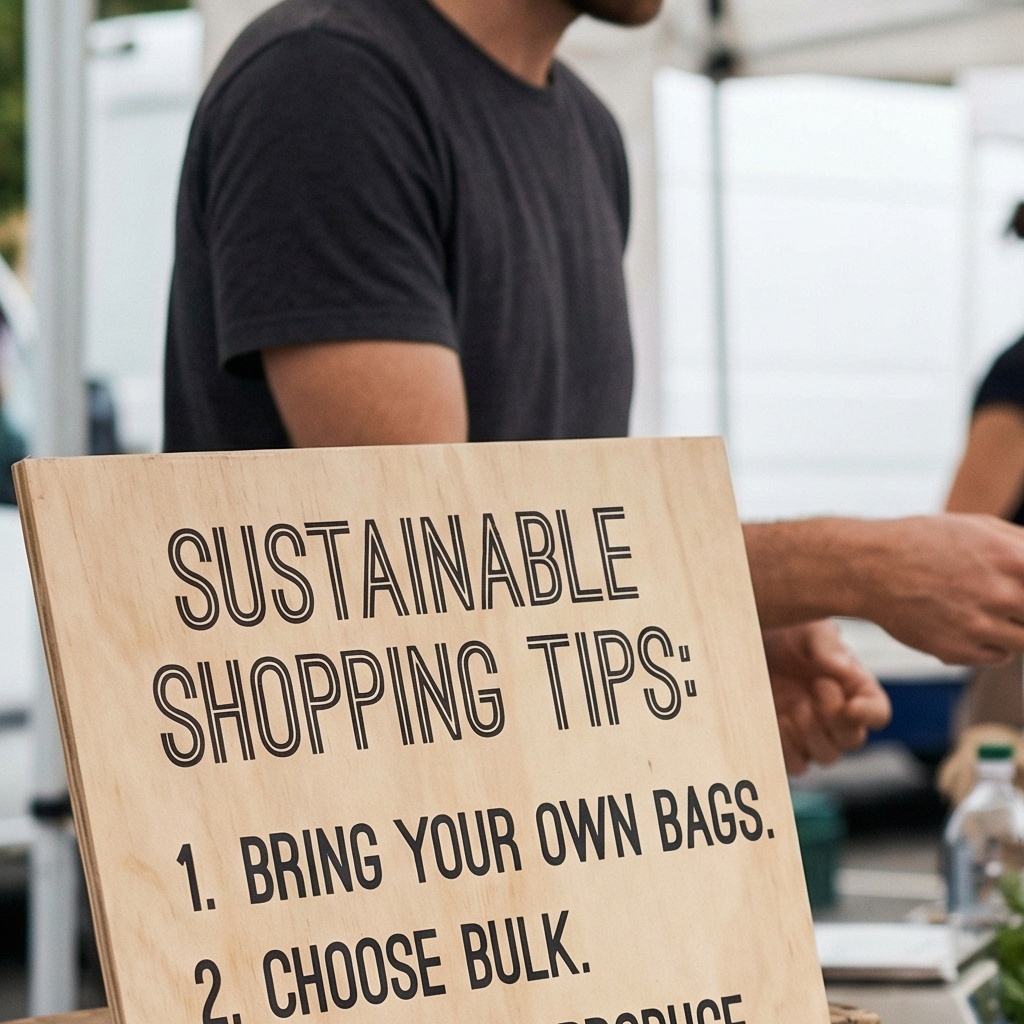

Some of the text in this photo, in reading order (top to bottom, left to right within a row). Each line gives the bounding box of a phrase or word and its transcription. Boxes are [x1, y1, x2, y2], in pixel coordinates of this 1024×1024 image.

[167, 506, 640, 631] SUSTAINABLE
[152, 625, 697, 768] SHOPPING TIPS:
[176, 779, 775, 912] 1. BRING YOUR OWN BAGS.
[262, 928, 447, 1019] CHOOSE
[460, 910, 591, 991] BULK.
